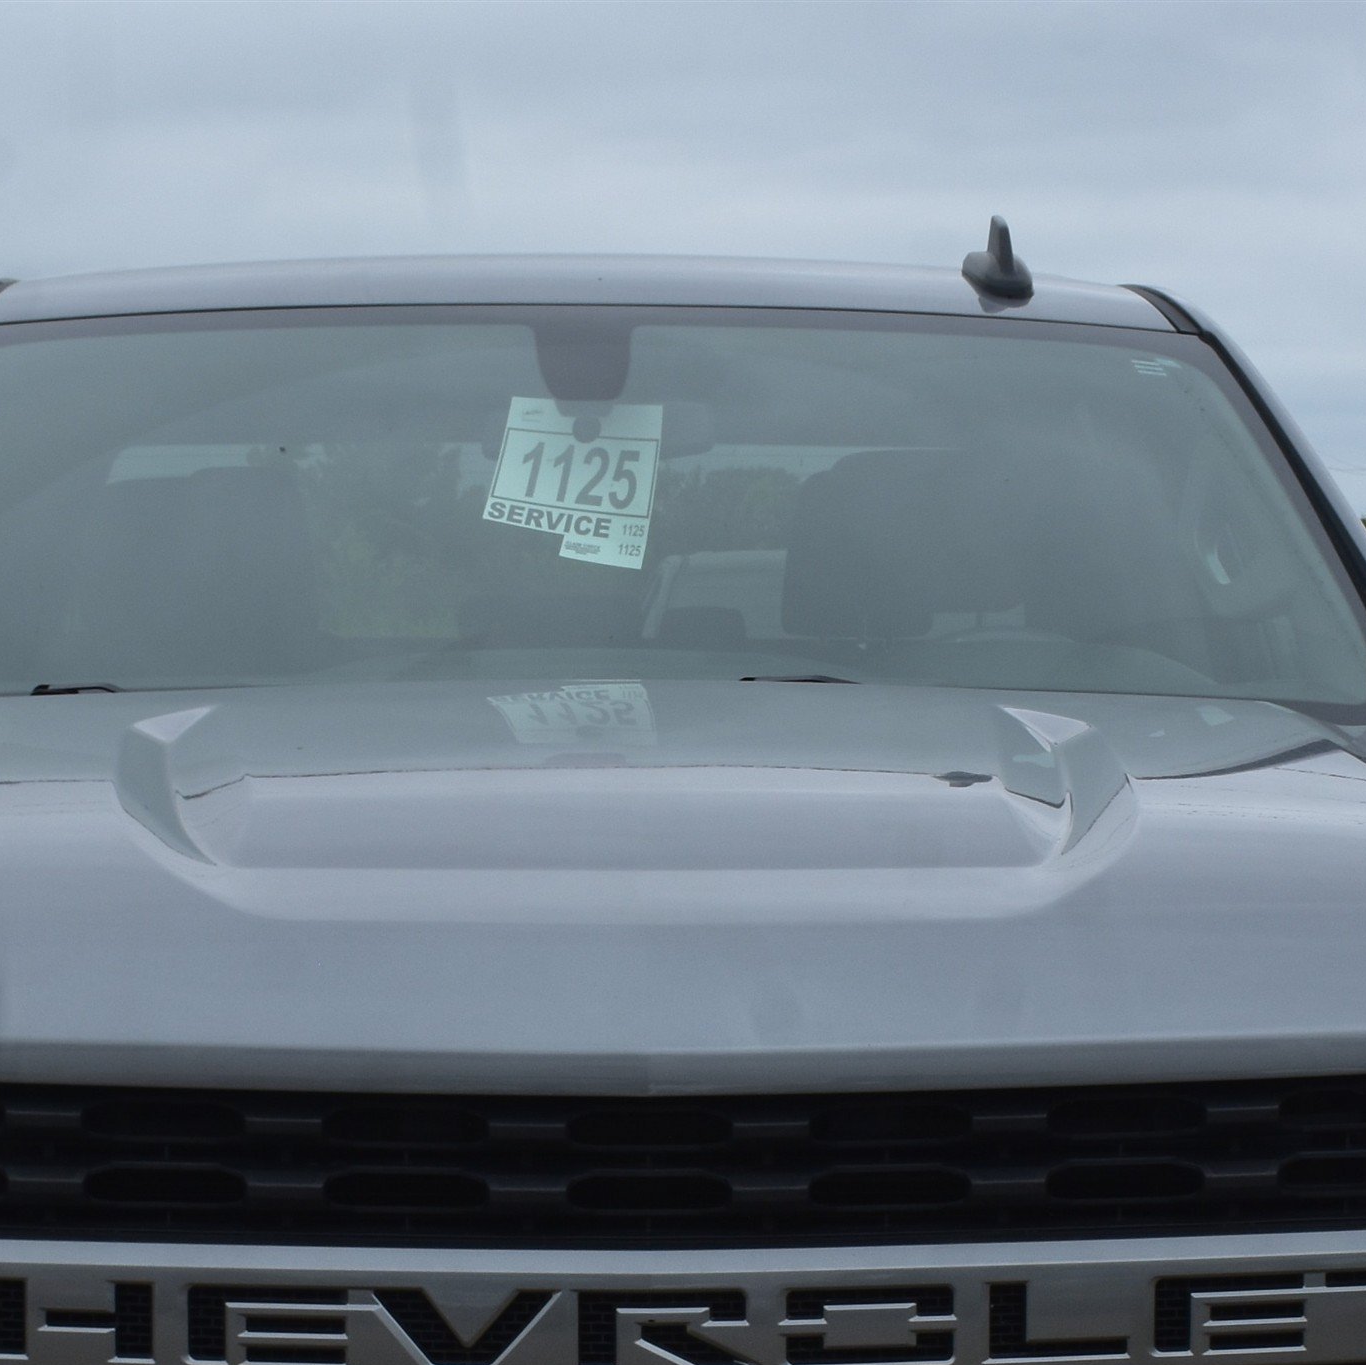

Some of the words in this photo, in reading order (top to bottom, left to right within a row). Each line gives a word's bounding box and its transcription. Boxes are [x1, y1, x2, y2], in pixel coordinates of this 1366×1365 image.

[522, 441, 640, 510] 1125
[487, 502, 612, 538] SERVICE
[622, 524, 645, 537] 1125
[618, 544, 642, 557] 1125
